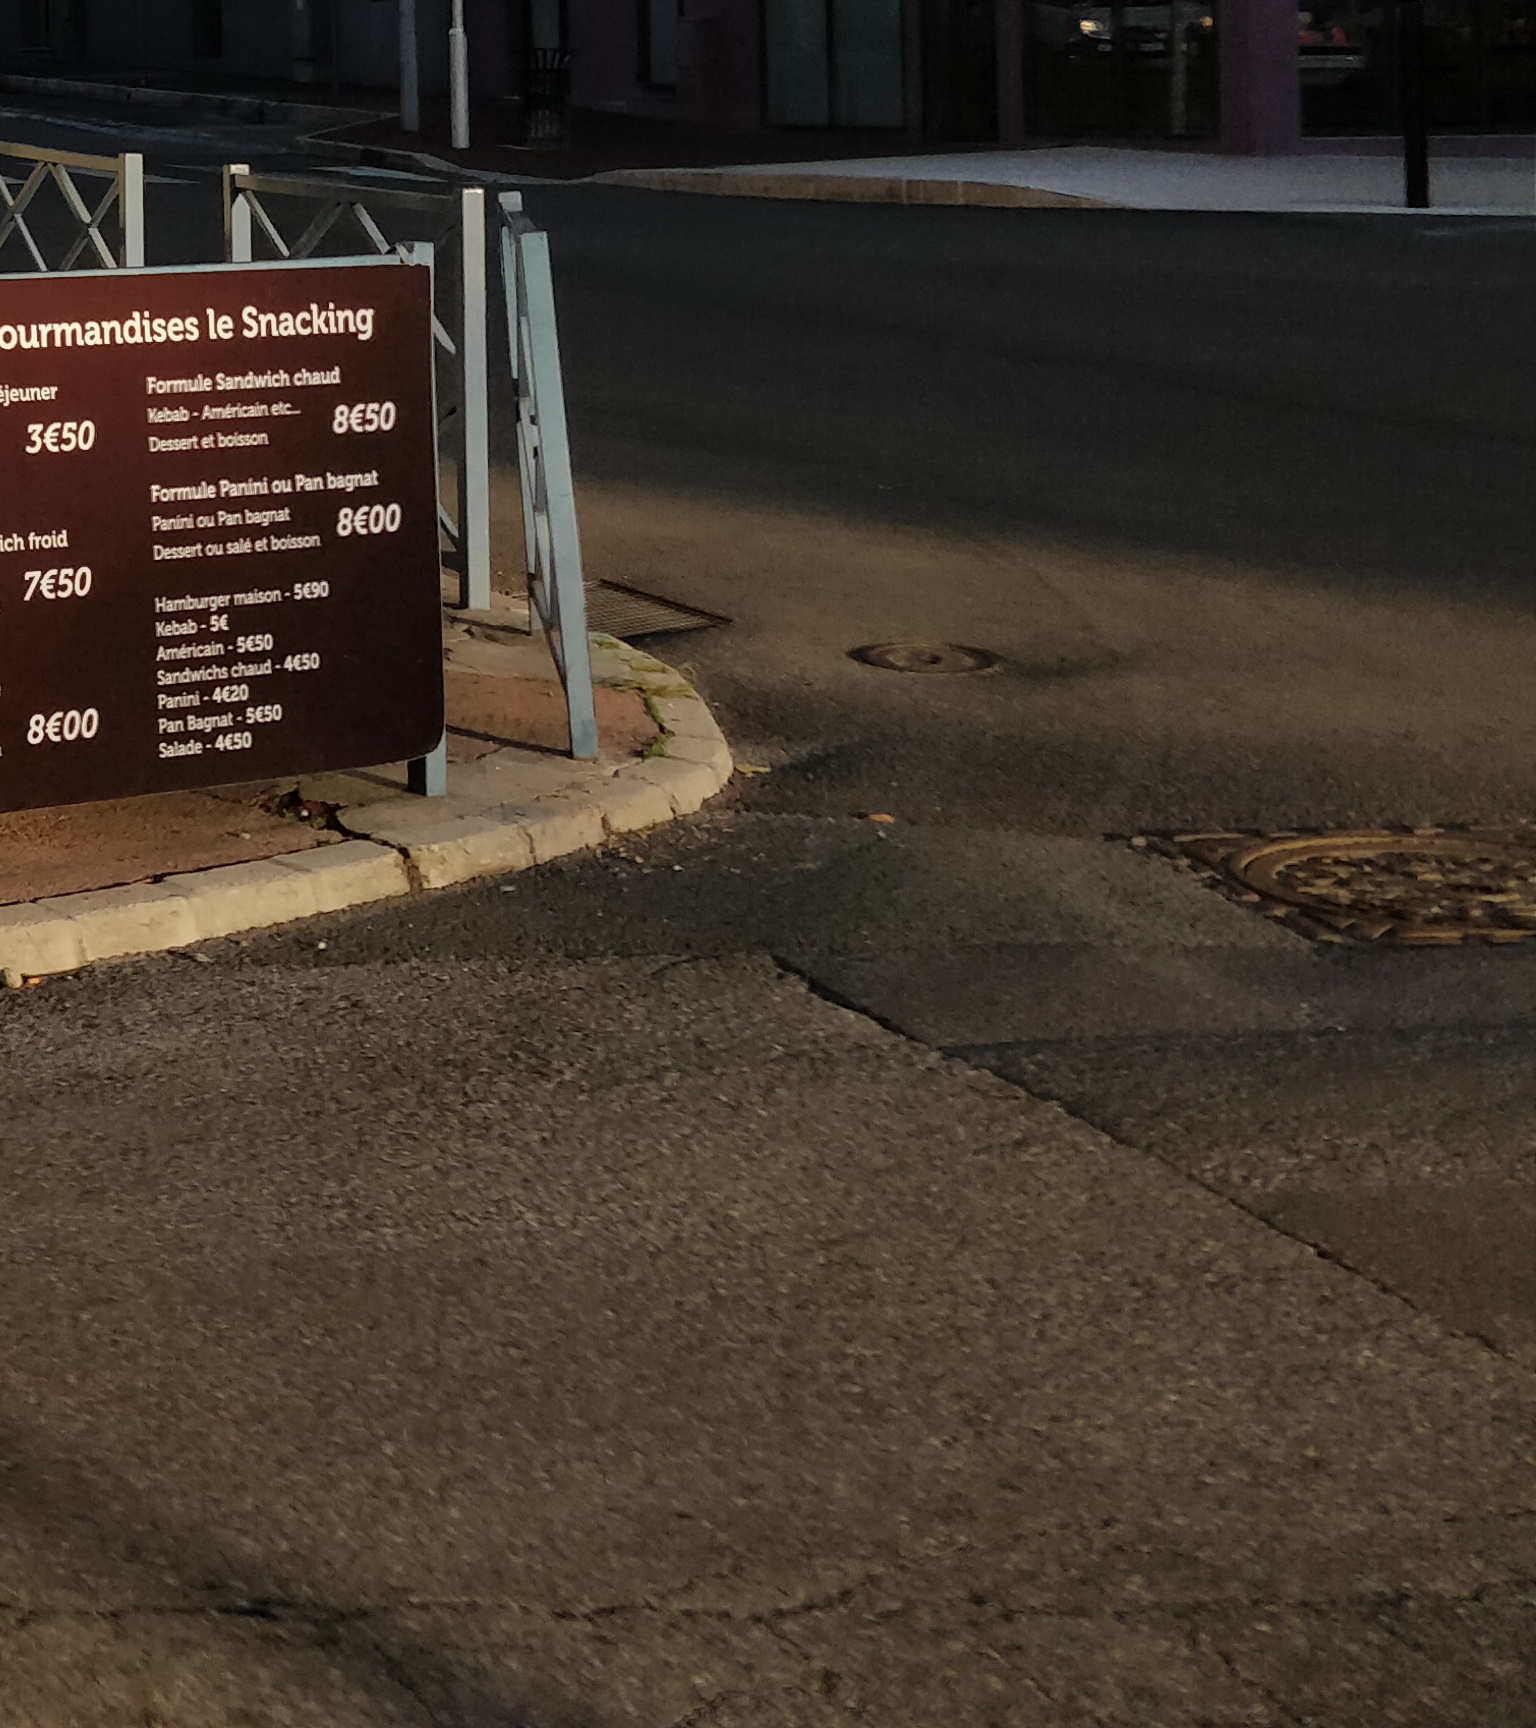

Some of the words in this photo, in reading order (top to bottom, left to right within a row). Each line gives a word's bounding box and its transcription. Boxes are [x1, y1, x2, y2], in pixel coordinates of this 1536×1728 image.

[206, 308, 234, 340] le
[242, 302, 375, 340] Snacking
[146, 373, 212, 394] Formule
[216, 369, 290, 391] Sandwich
[293, 365, 341, 386] chaud
[146, 406, 190, 424] Kebab
[201, 400, 269, 421] Américain
[332, 401, 396, 434] 8€50
[25, 420, 96, 454] 3€50
[148, 434, 198, 452] Dessert
[201, 434, 215, 449] et
[218, 430, 269, 448] boisson
[150, 480, 216, 503] Formule
[219, 477, 269, 499] Panini
[271, 479, 292, 494] ou
[295, 473, 324, 492] Pan
[326, 469, 379, 491] bagnat
[152, 514, 194, 532] Panini
[196, 514, 215, 529] ou
[217, 510, 242, 527] Pan
[244, 506, 291, 527] bagnat
[336, 502, 402, 537] 8€00
[27, 529, 68, 551] froid
[153, 543, 203, 561] Dessert
[205, 543, 224, 557] ou
[226, 536, 251, 555] salé
[254, 538, 269, 552] et
[270, 533, 321, 551] boisson
[23, 566, 92, 601] 7€50
[154, 594, 231, 613] Hamburger
[233, 588, 283, 606] maison
[292, 581, 330, 600] 5€90
[155, 619, 198, 638] Kebab
[209, 614, 230, 632] 5€
[155, 640, 225, 662] Américain
[236, 634, 274, 654] 5€50
[156, 664, 228, 686] Sandwichs
[231, 659, 273, 678] chaud
[283, 653, 321, 672] 4€50
[157, 690, 201, 710] Panini
[212, 684, 250, 703] 4€20
[27, 708, 99, 745] 8€00
[158, 718, 184, 734] Pan
[186, 712, 234, 733] Bagnat
[245, 704, 283, 724] 5€50
[158, 739, 203, 759] Salade
[214, 732, 252, 751] 4€50
